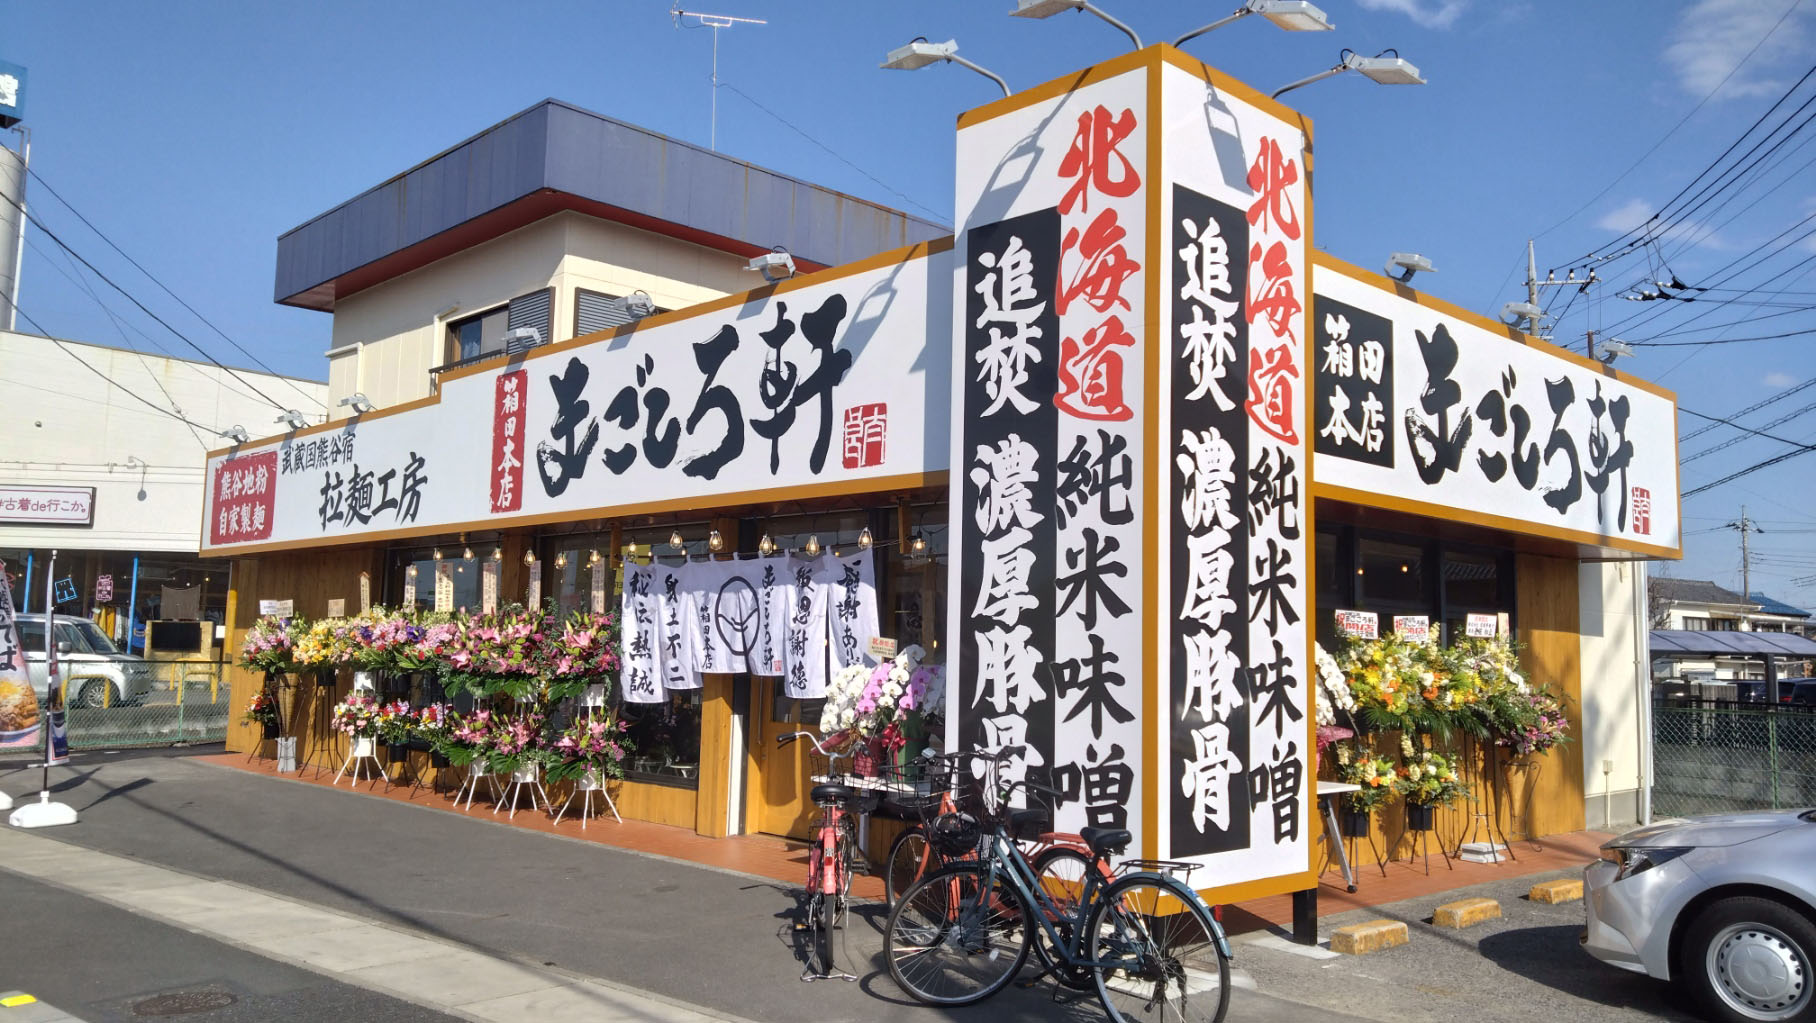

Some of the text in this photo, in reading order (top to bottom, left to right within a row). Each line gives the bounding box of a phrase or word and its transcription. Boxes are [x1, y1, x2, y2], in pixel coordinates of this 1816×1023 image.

[281, 432, 356, 475] 武蔵国熊谷宿
[497, 376, 521, 508] 箱田本店
[537, 293, 852, 497] まごころ軒
[1405, 323, 1634, 532] まごころ軒
[219, 464, 269, 502] 熊谷地粉
[664, 573, 686, 683] 身土不二
